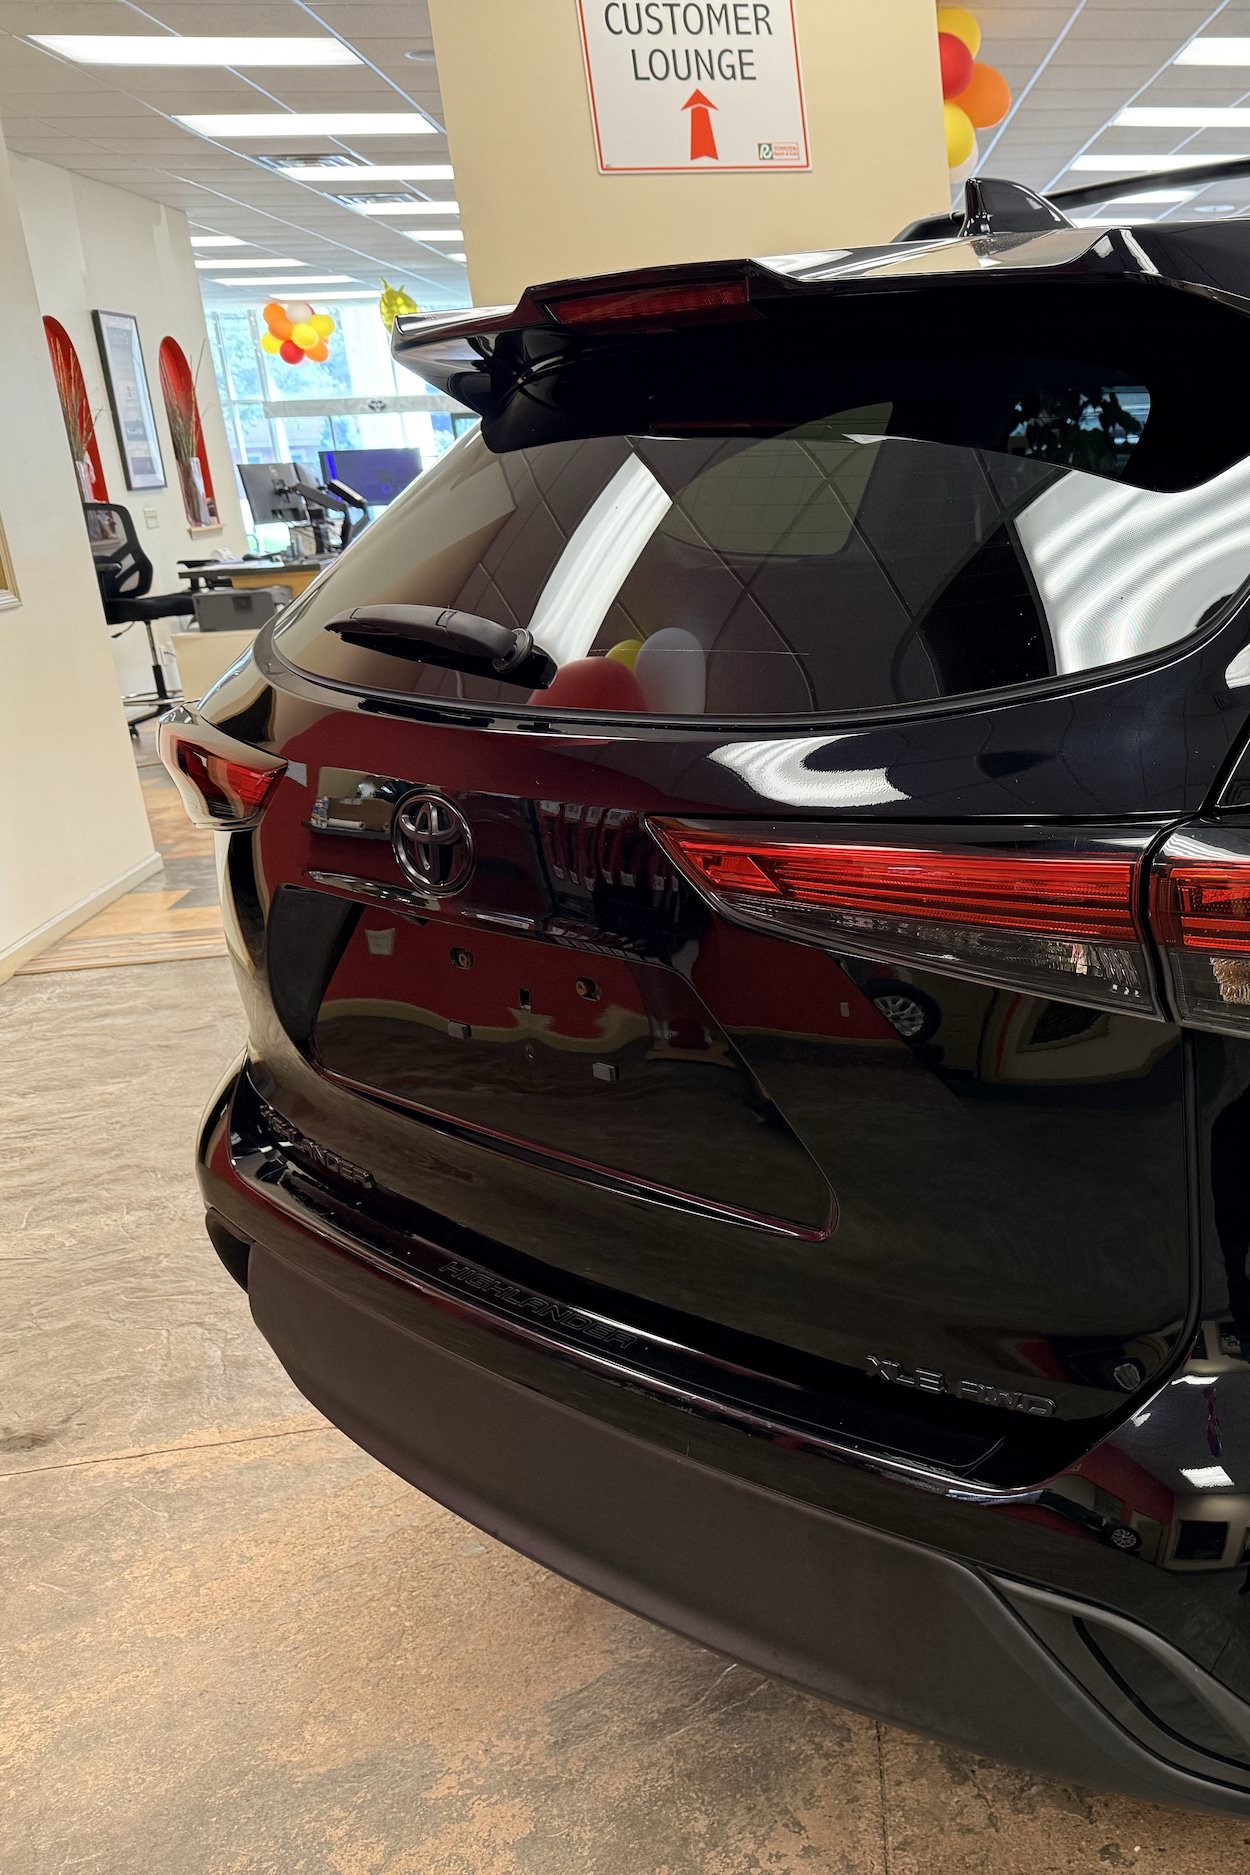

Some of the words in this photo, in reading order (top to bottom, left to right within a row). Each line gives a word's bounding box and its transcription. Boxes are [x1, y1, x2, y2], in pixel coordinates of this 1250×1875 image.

[604, 3, 773, 36] CUSTOMER
[631, 49, 757, 81] LOUNGE
[438, 1261, 639, 1350] HIGHLANDER
